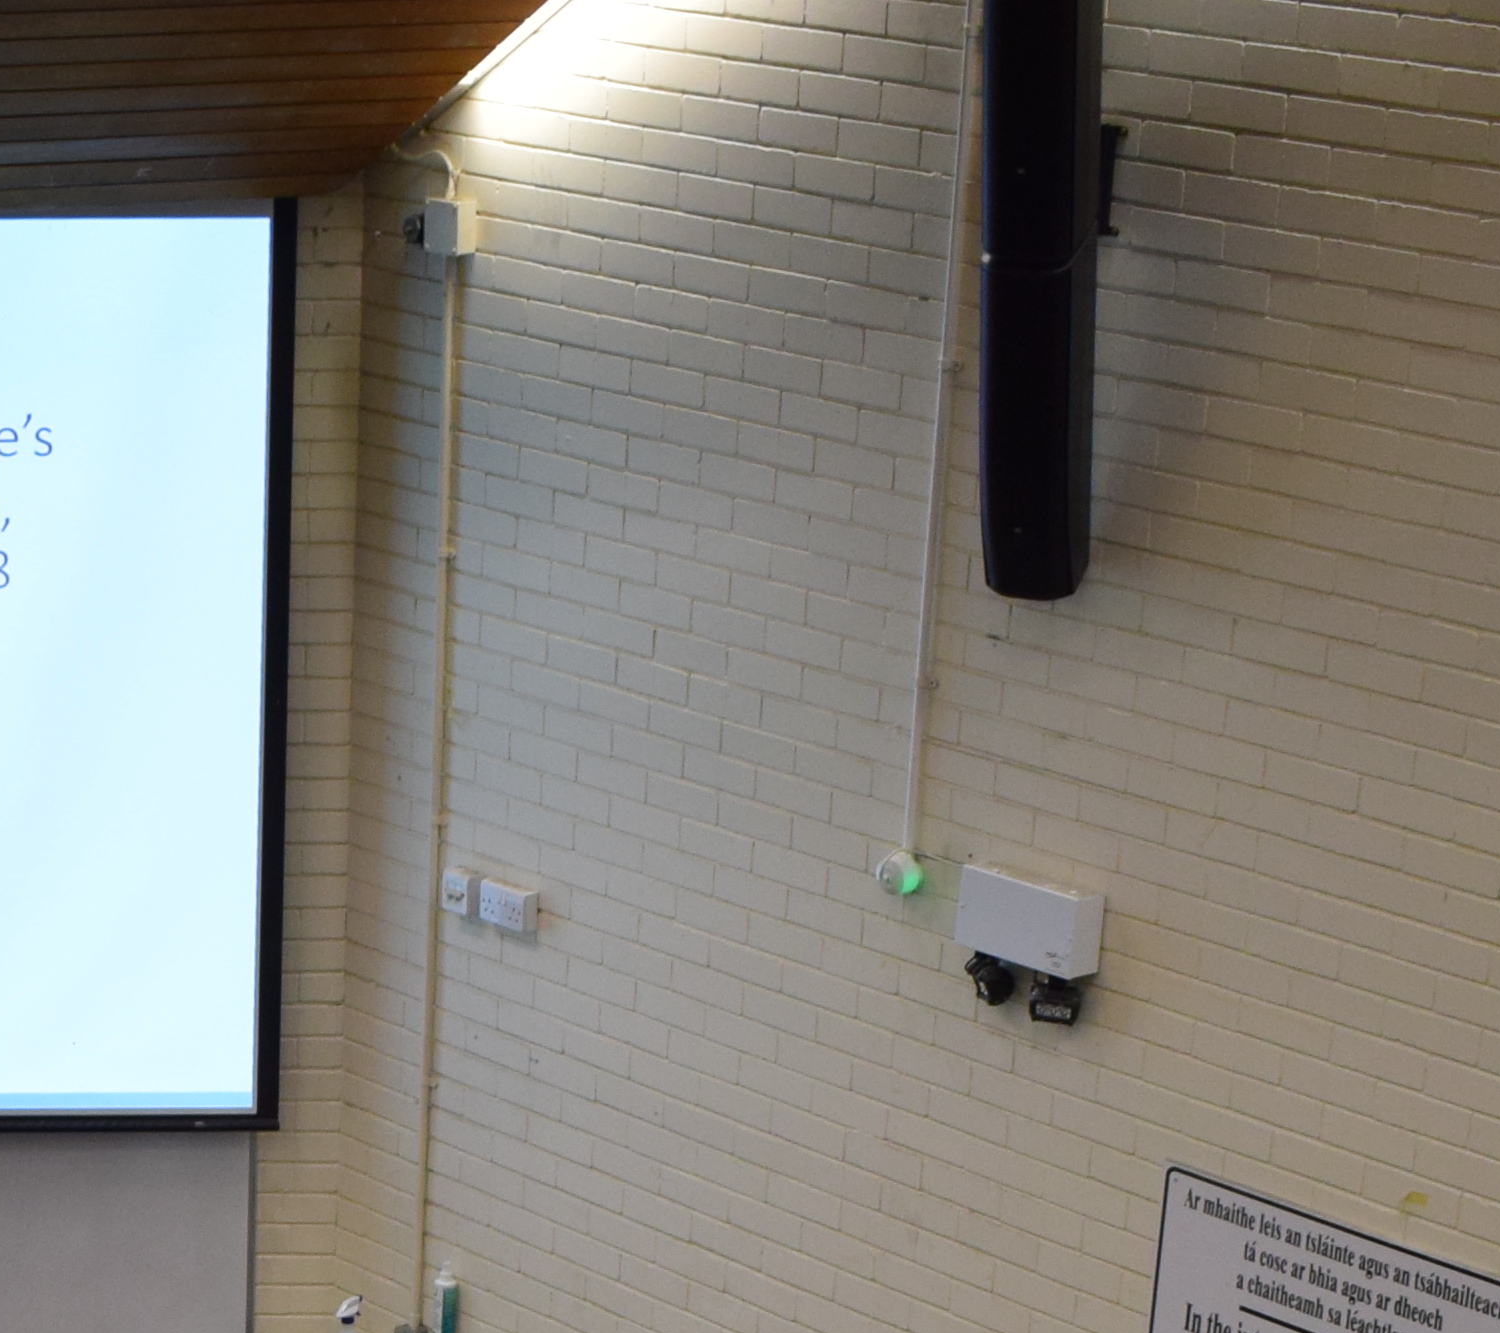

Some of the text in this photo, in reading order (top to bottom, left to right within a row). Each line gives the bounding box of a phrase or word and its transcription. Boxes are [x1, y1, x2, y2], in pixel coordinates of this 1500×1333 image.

[1185, 1187, 1201, 1211] Ar
[1201, 1196, 1256, 1231] mhaithe
[1257, 1212, 1282, 1241] leis
[1283, 1227, 1302, 1248] an
[1304, 1231, 1356, 1267] tsláinte
[1357, 1253, 1390, 1280] agus
[1391, 1265, 1411, 1287] an
[1235, 1273, 1244, 1290] a
[1246, 1274, 1324, 1320] chaitheamh
[1326, 1306, 1342, 1327] sa
[1242, 1240, 1444, 1332] tá cosc ar bhia agus ar dheoch
